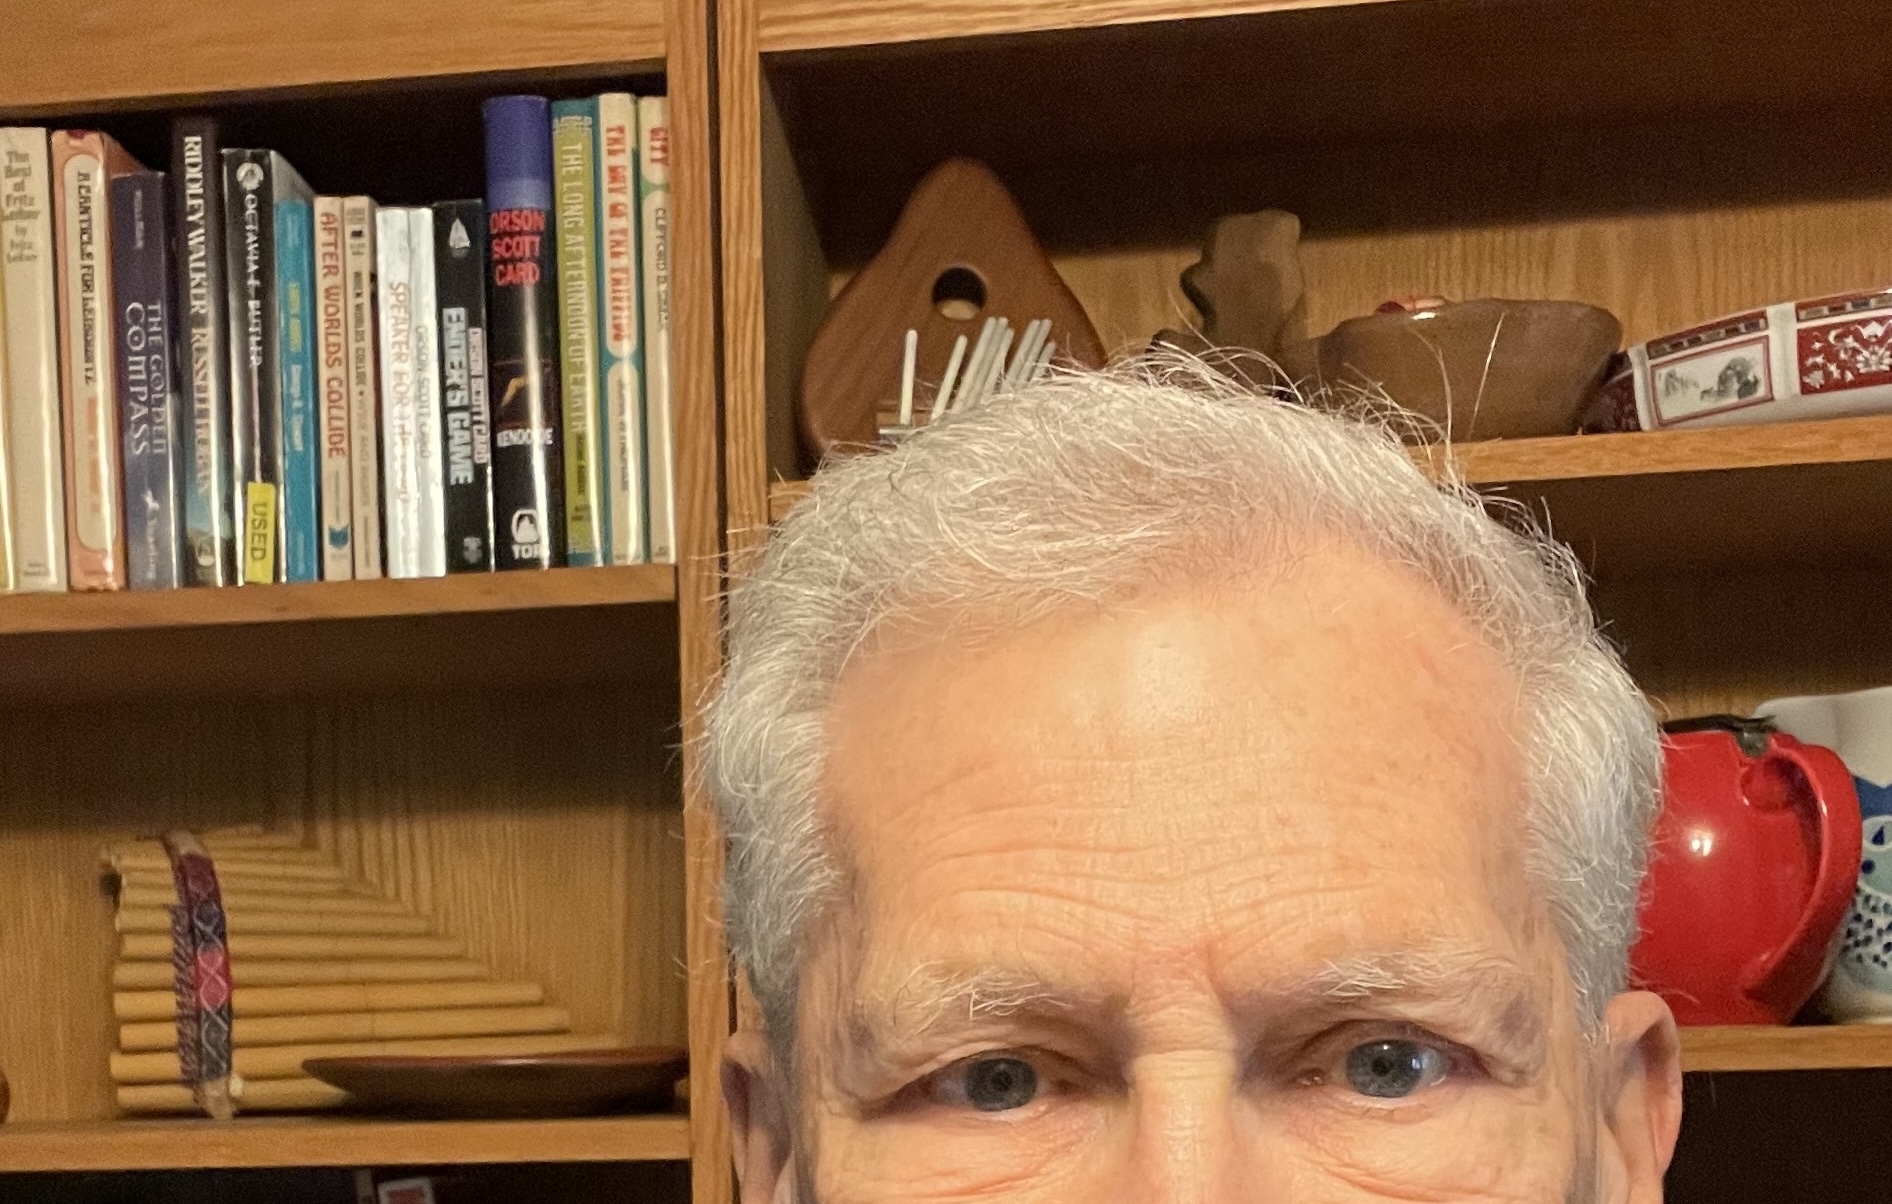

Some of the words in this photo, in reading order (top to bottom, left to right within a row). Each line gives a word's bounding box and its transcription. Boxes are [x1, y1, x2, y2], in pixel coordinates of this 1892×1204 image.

[560, 143, 584, 175] THE
[606, 126, 626, 158] THE
[650, 127, 670, 168] CITY
[184, 136, 205, 224] RIDDLEY
[560, 181, 585, 230] LONG
[607, 164, 628, 196] DAY
[78, 184, 94, 262] CANTICLE
[244, 193, 260, 274] OCTAVIA
[489, 207, 546, 235] ORSON
[609, 202, 628, 221] OF
[187, 226, 208, 315] WALKER
[320, 212, 341, 278] AFTER
[491, 235, 542, 261] SCOTT
[494, 261, 541, 287] CARD
[609, 227, 630, 260] THE
[81, 264, 95, 294] FOR
[563, 232, 588, 341] AFTERNOON
[147, 302, 163, 347] THE
[247, 300, 264, 367] BUTLER
[324, 285, 343, 369] WORLDS
[389, 282, 412, 364] SPEAKER
[415, 325, 430, 373] ORSON
[126, 302, 151, 455] COMPASS
[442, 307, 471, 408] ENDER'S
[566, 344, 588, 368] OF
[149, 354, 168, 455] GOLDEN
[326, 377, 348, 459] COLLIDE
[417, 377, 433, 421] SCOTT
[568, 372, 590, 434] EARTH
[447, 410, 475, 487] GAME
[249, 502, 269, 563] USED
